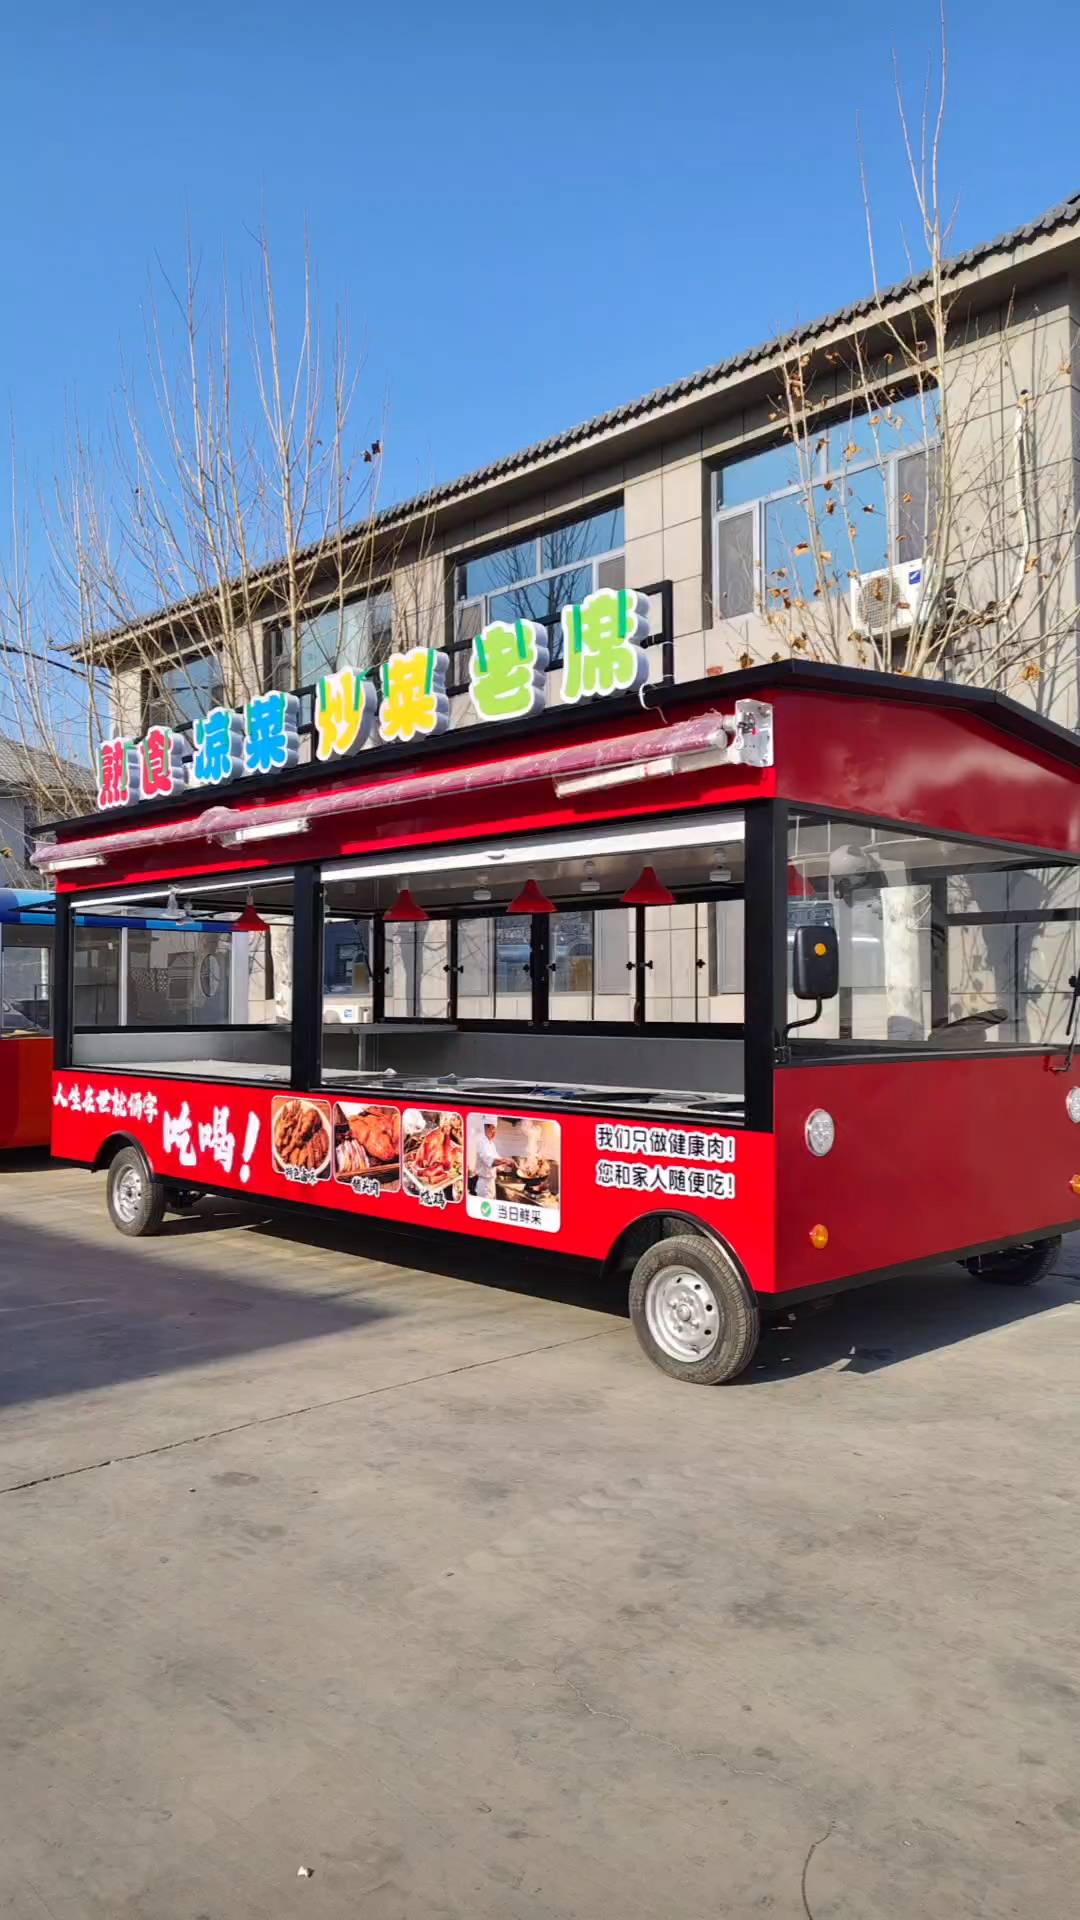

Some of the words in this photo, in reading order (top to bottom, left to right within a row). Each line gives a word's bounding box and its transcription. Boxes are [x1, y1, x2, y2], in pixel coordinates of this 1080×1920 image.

[597, 1126, 733, 1160] 我们只做健康肉！
[597, 1162, 733, 1196] 您和家人随便吃！
